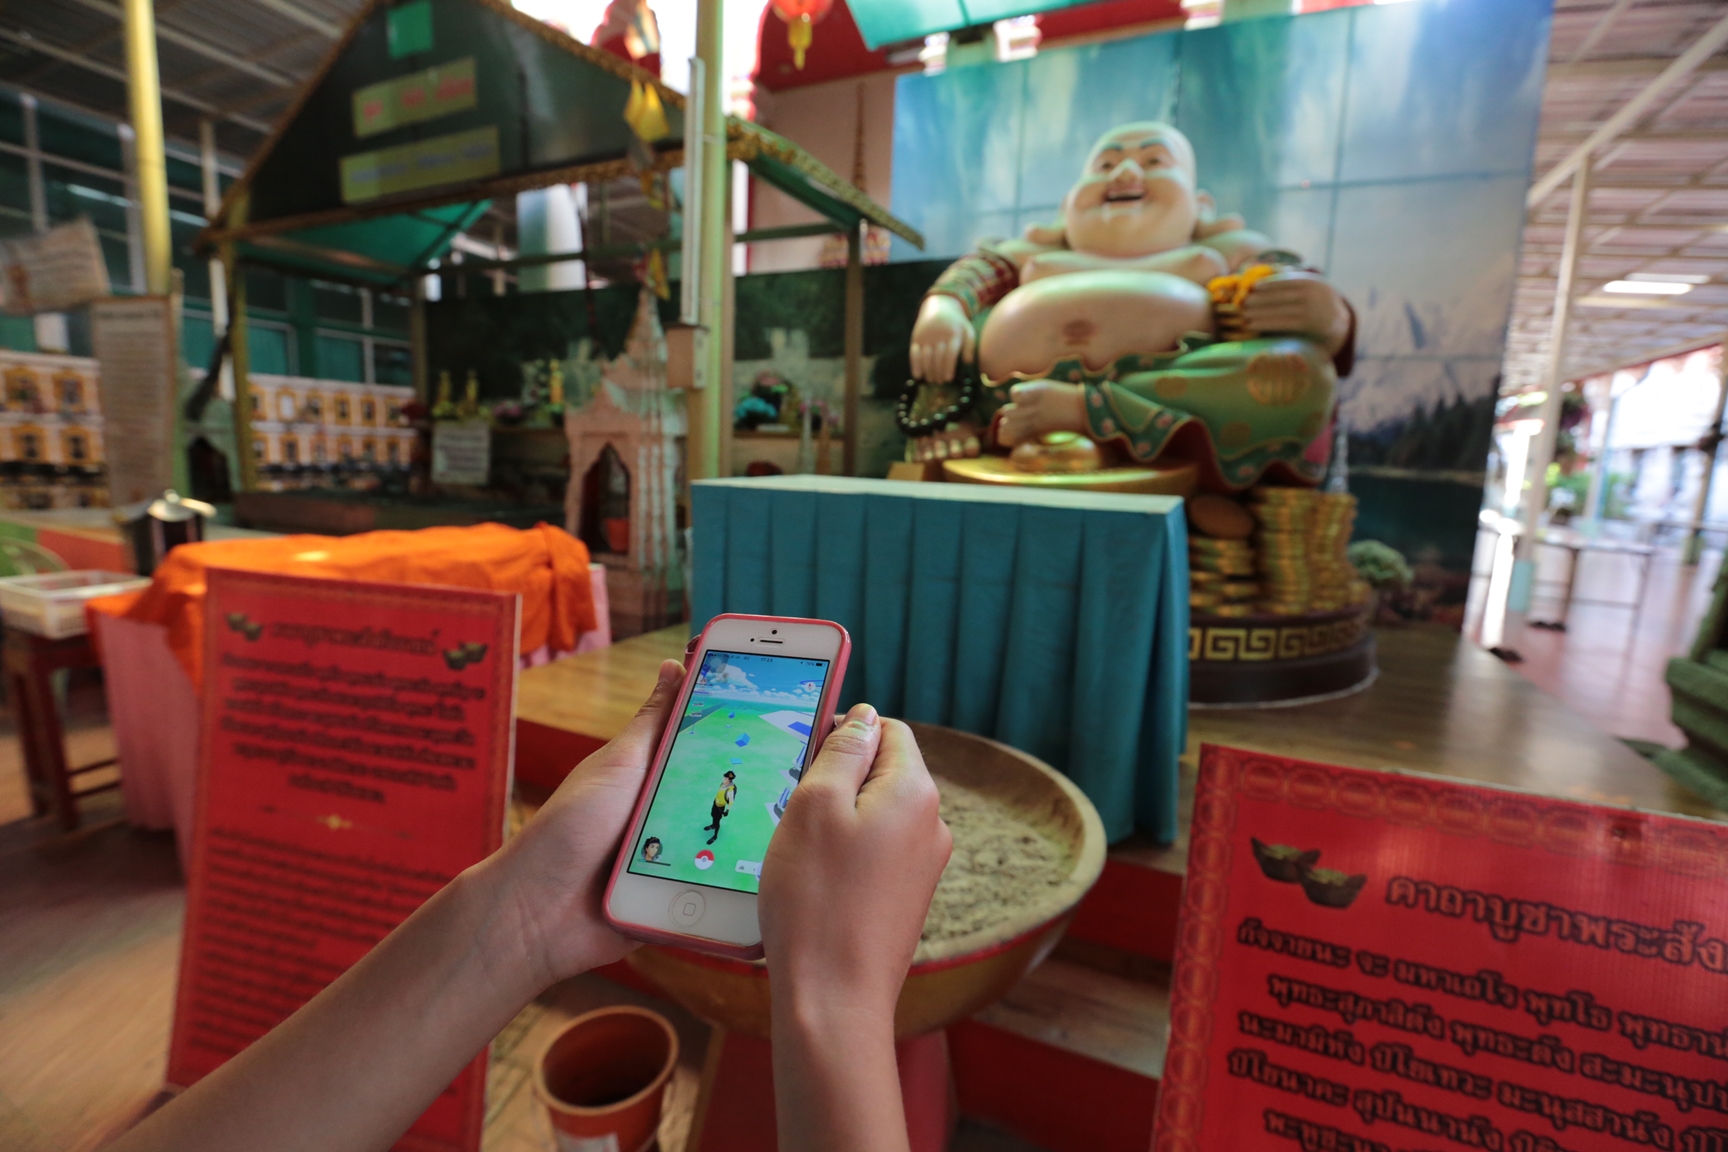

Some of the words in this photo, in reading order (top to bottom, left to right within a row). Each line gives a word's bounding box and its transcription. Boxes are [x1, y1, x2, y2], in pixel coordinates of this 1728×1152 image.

[1385, 875, 1728, 974] คาถาบูชาพระสัง
[1355, 949, 1390, 977] จะ
